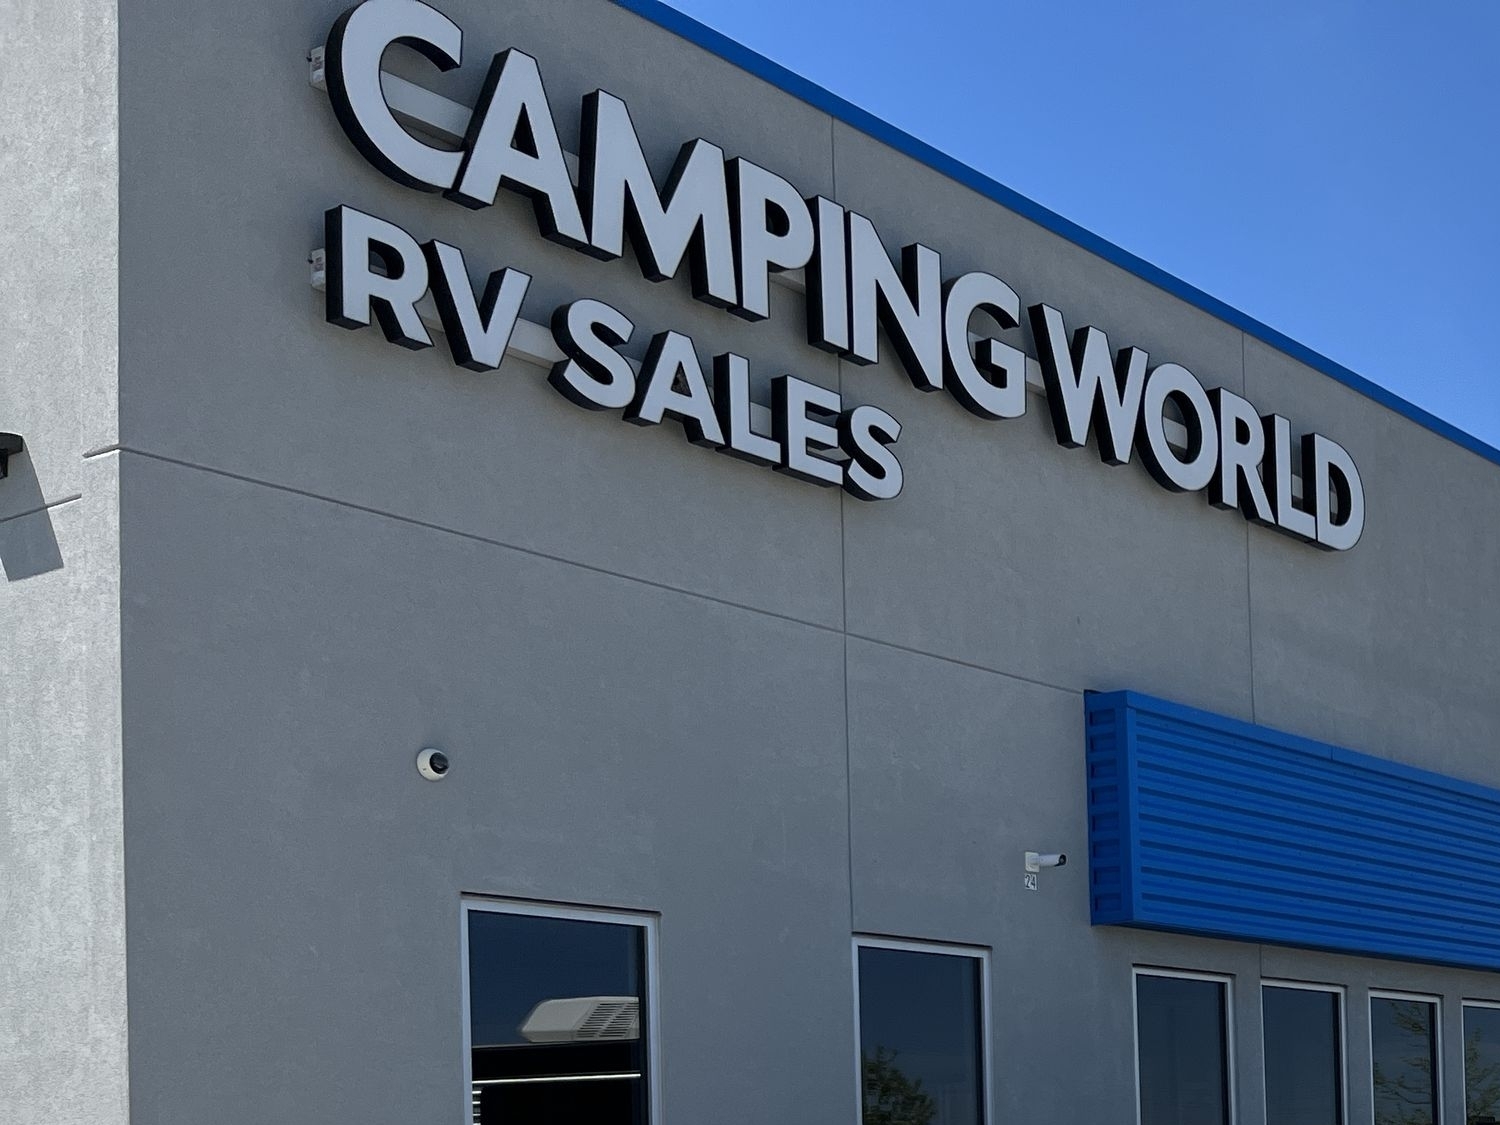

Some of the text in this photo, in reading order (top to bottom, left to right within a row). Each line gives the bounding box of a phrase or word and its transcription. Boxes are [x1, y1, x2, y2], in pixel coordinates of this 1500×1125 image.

[325, 204, 904, 500] RV SALES
[326, 0, 1364, 551] CAMPING WORLD
[1025, 873, 1037, 890] 24
